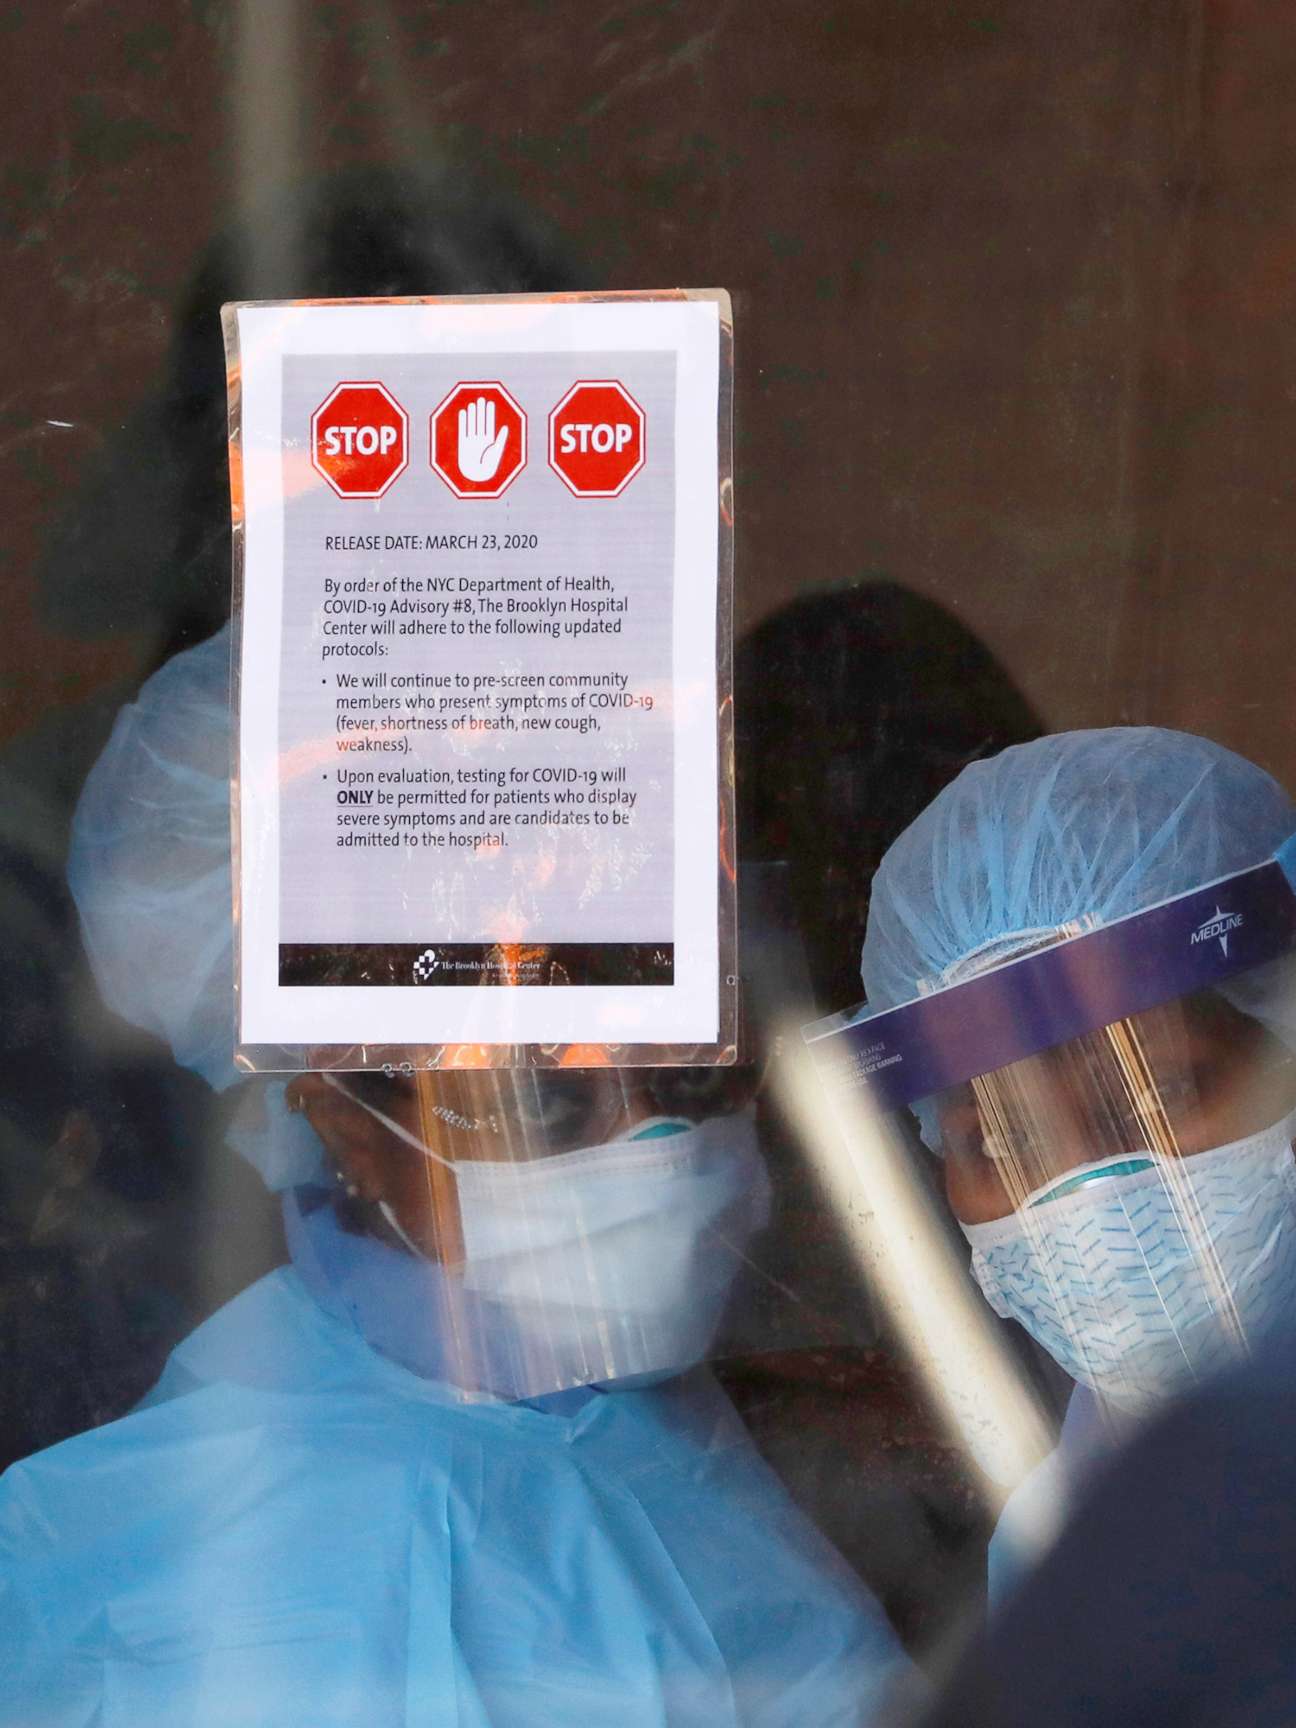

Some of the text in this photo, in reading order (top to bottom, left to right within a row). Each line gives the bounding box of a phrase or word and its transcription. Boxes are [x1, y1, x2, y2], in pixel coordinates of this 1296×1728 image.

[324, 423, 632, 455] STOP STOP
[326, 535, 537, 551] RELEASE DATE: MARCH 23, 2020
[325, 576, 614, 596] By order of the NYC Department of Health,
[324, 597, 627, 618] COVID-19 Advisory #8, The Brooklyn Hospital
[323, 618, 621, 638] Center will adhere to the following updated
[322, 641, 388, 658] protocols:
[336, 672, 628, 691] We will continue to pre-screen community
[337, 693, 653, 713] members who present symptoms of COVID-19
[337, 715, 600, 734] (fever, shortness of breath, new cough,
[337, 736, 412, 754] weakness).
[338, 767, 625, 787] Upon evaluation, testing for COVID-19 will
[337, 788, 637, 808] ONLY be permitted for patients who display
[337, 810, 629, 830] severe symptoms and are candidates to be
[337, 832, 508, 850] admitted to the hospital.
[1190, 913, 1244, 944] MEDLINE
[441, 961, 454, 970] The
